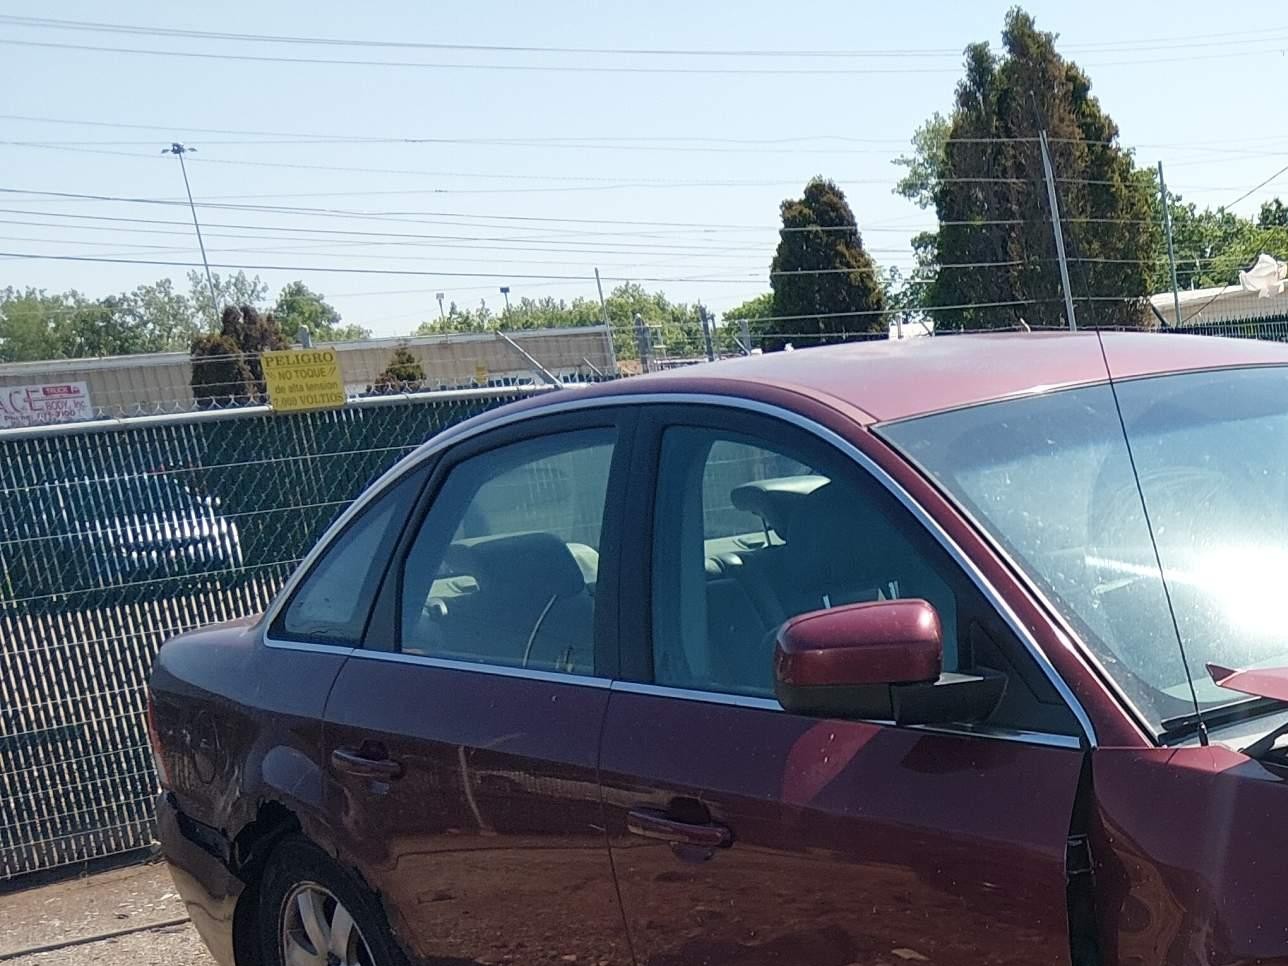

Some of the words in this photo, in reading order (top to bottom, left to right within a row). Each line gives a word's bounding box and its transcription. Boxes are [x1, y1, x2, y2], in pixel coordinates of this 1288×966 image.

[264, 352, 333, 367] PELIGRO
[278, 369, 293, 380] NO
[299, 393, 343, 406] VOLTIOS
